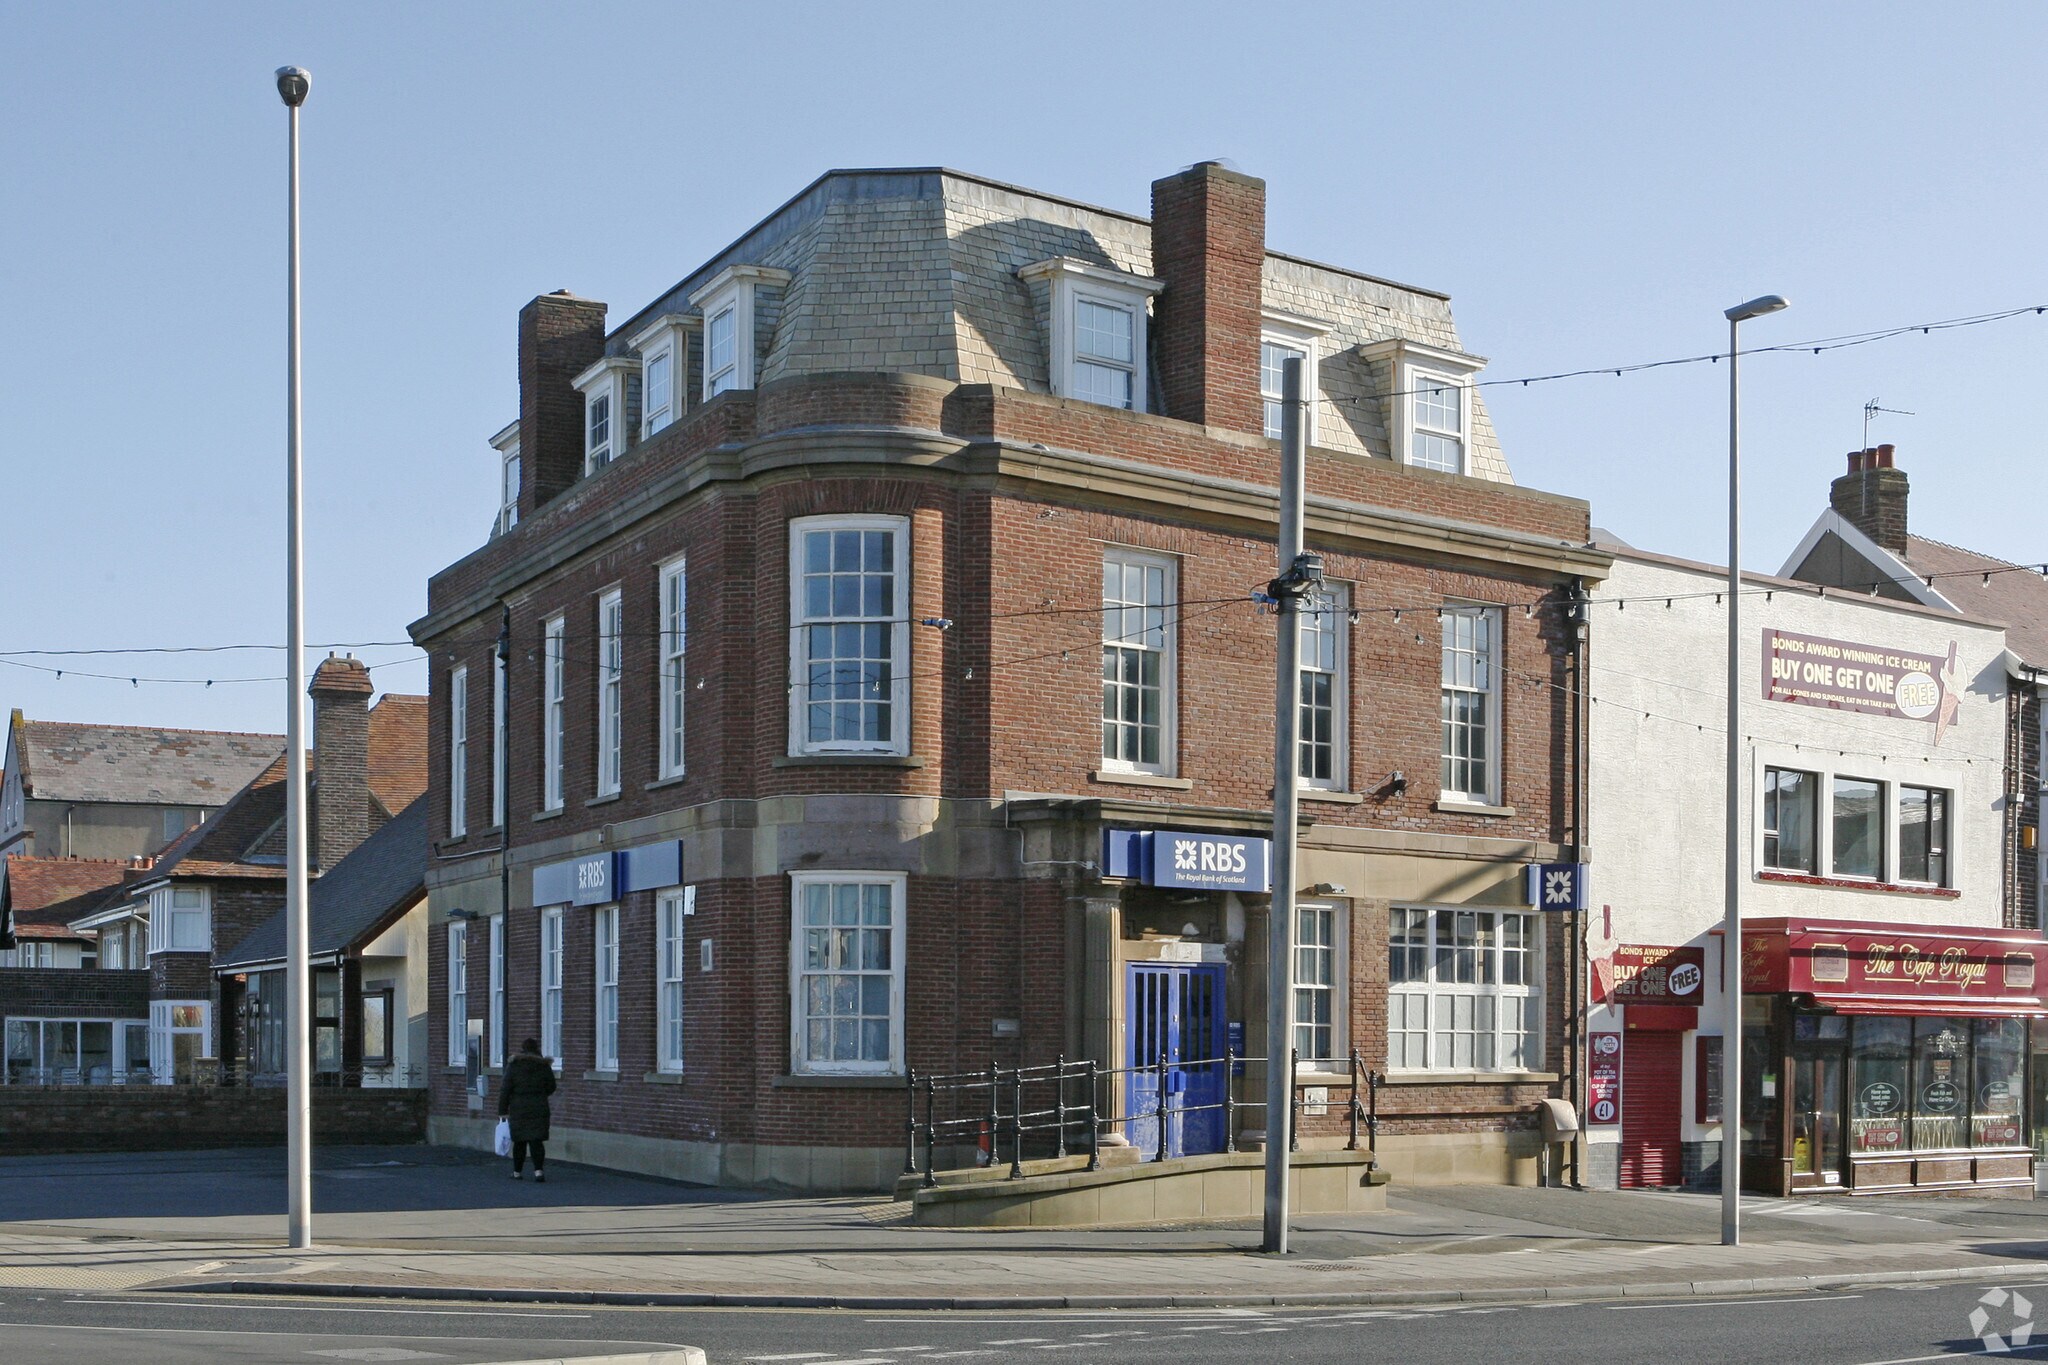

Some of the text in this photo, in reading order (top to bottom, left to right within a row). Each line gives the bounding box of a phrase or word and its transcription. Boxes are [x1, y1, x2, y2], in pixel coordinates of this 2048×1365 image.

[1772, 637, 1931, 673] BONDS AWARD WINNING ICE CREAM
[1771, 657, 1894, 695] BUY ONE GET ONE
[1793, 689, 1809, 699] CONES
[1810, 692, 1821, 700] AND
[1846, 696, 1855, 704] EAT
[1856, 697, 1862, 705] IN
[1862, 698, 1869, 706] OR
[1870, 699, 1882, 708] TAKE
[1882, 701, 1896, 710] AWAY
[1900, 682, 1936, 708] FREE
[1202, 842, 1246, 873] RBS
[588, 860, 604, 888] RBS
[1186, 874, 1201, 882] Royal
[1216, 875, 1223, 884] of
[1223, 876, 1246, 884] Scotland
[1620, 947, 1643, 956] BONDS
[1644, 948, 1669, 957] AWARD
[1747, 938, 1768, 952] The
[1614, 966, 1666, 981] BUY ONE
[1864, 943, 1895, 974] The
[1899, 944, 1937, 985] Café
[1939, 947, 1989, 989] Royal
[1615, 980, 1666, 995] GET ONE
[1671, 968, 1698, 992] FREE
[1599, 1103, 1608, 1117] £1
